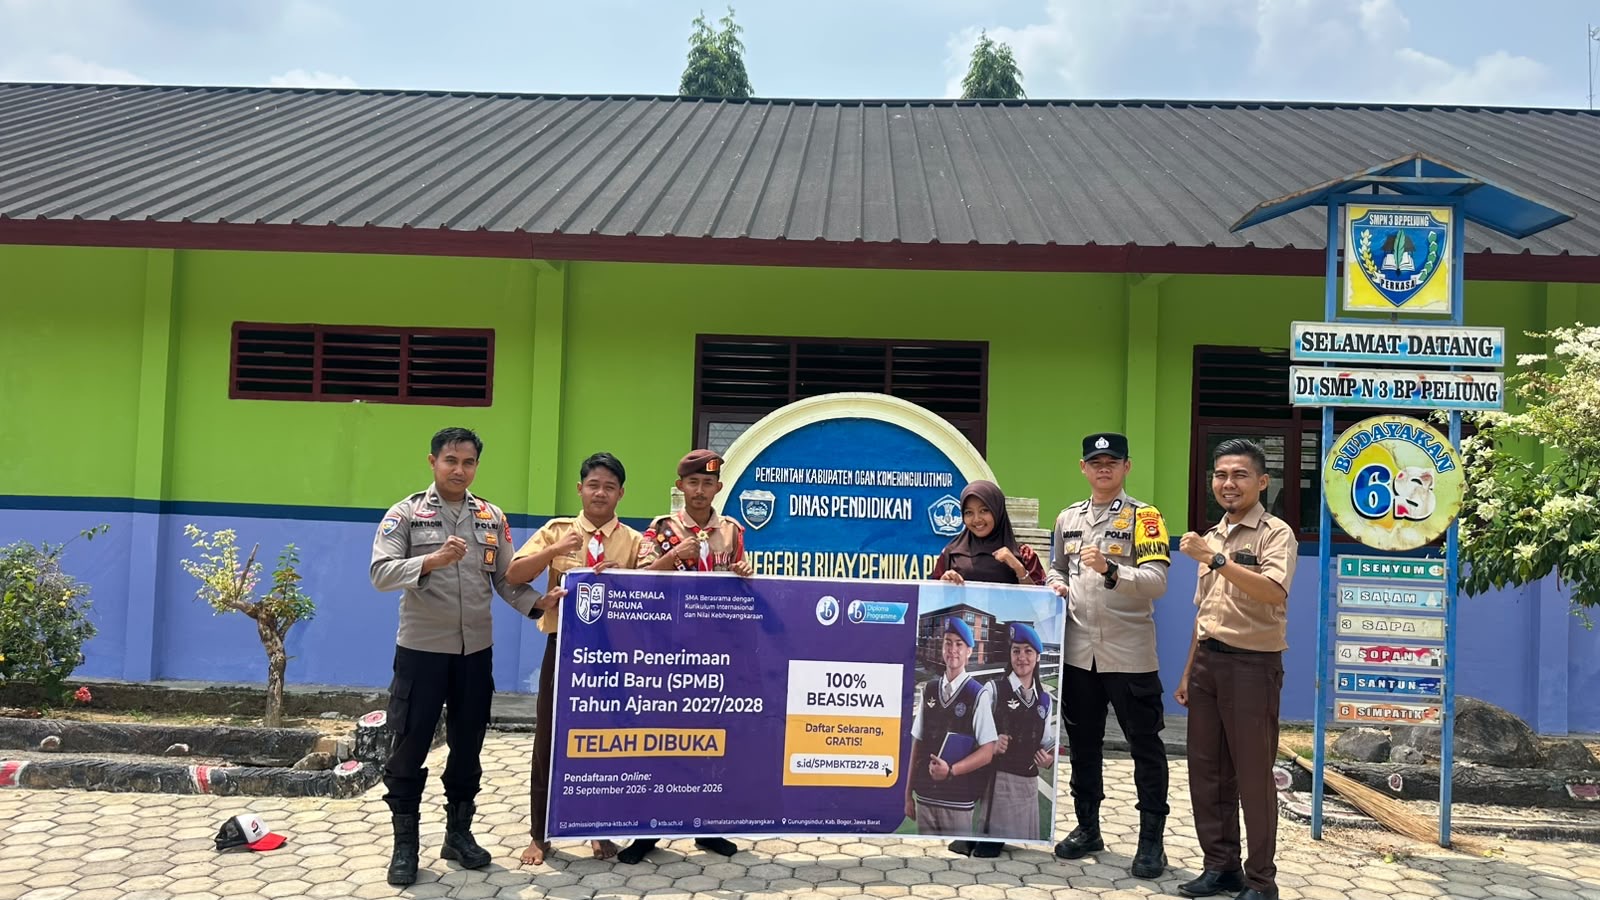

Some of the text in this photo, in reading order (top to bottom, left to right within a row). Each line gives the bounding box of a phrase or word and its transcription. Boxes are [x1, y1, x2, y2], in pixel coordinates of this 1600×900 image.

[1369, 214, 1388, 225] SMPN
[1389, 215, 1394, 226] 3
[1380, 279, 1416, 290] PERKASA
[1302, 332, 1494, 357] SELAMAT DATANG
[1296, 376, 1498, 402] DI SMP N 3 BP PELIUNG
[1332, 422, 1456, 474] BUDAYAKAN
[756, 467, 953, 487] PEMERINTAH KABUPATEN OGAN KOMERINGULUTIMUR
[790, 494, 912, 520] DINAS PENDIDIKAN
[475, 522, 498, 530] POLRI
[1105, 531, 1131, 540] POLRI
[801, 552, 811, 576] 3
[1346, 563, 1425, 574] 1 SENYUM
[608, 590, 665, 600] SMA KEMALA
[1344, 590, 1416, 603] 2 SALAM
[608, 600, 643, 610] TARUNA
[867, 604, 889, 612] Diploma
[607, 611, 672, 621] BHAYANGKARA
[711, 612, 763, 620] Kebhayangkaraan
[1342, 619, 1415, 632] 3 SAPA
[573, 648, 730, 666] Sistem Penerimaan
[1342, 649, 1414, 661] 4 SOPAN
[571, 672, 724, 692] Murid Baru (SPMB)
[826, 673, 867, 689] 100%
[1341, 678, 1416, 690] 5 SANTUN
[570, 695, 763, 714] Tahun Ajaran 2027/2028
[806, 692, 884, 708] BEASISWA
[1341, 706, 1423, 719] 6 SIMPATIK
[805, 723, 884, 736] Daftar Sekarang,
[574, 734, 718, 752] TELAH DIBUKA
[825, 737, 863, 746] GRATIS!
[796, 759, 879, 770] s.id/SPMBKTB27-28
[564, 772, 652, 783] Pendaftaran Online:
[563, 786, 574, 795] 28
[576, 785, 624, 797] September
[626, 785, 646, 794] 2026
[653, 785, 664, 793] 28
[666, 784, 701, 793] Oktober
[702, 784, 722, 793] 2026
